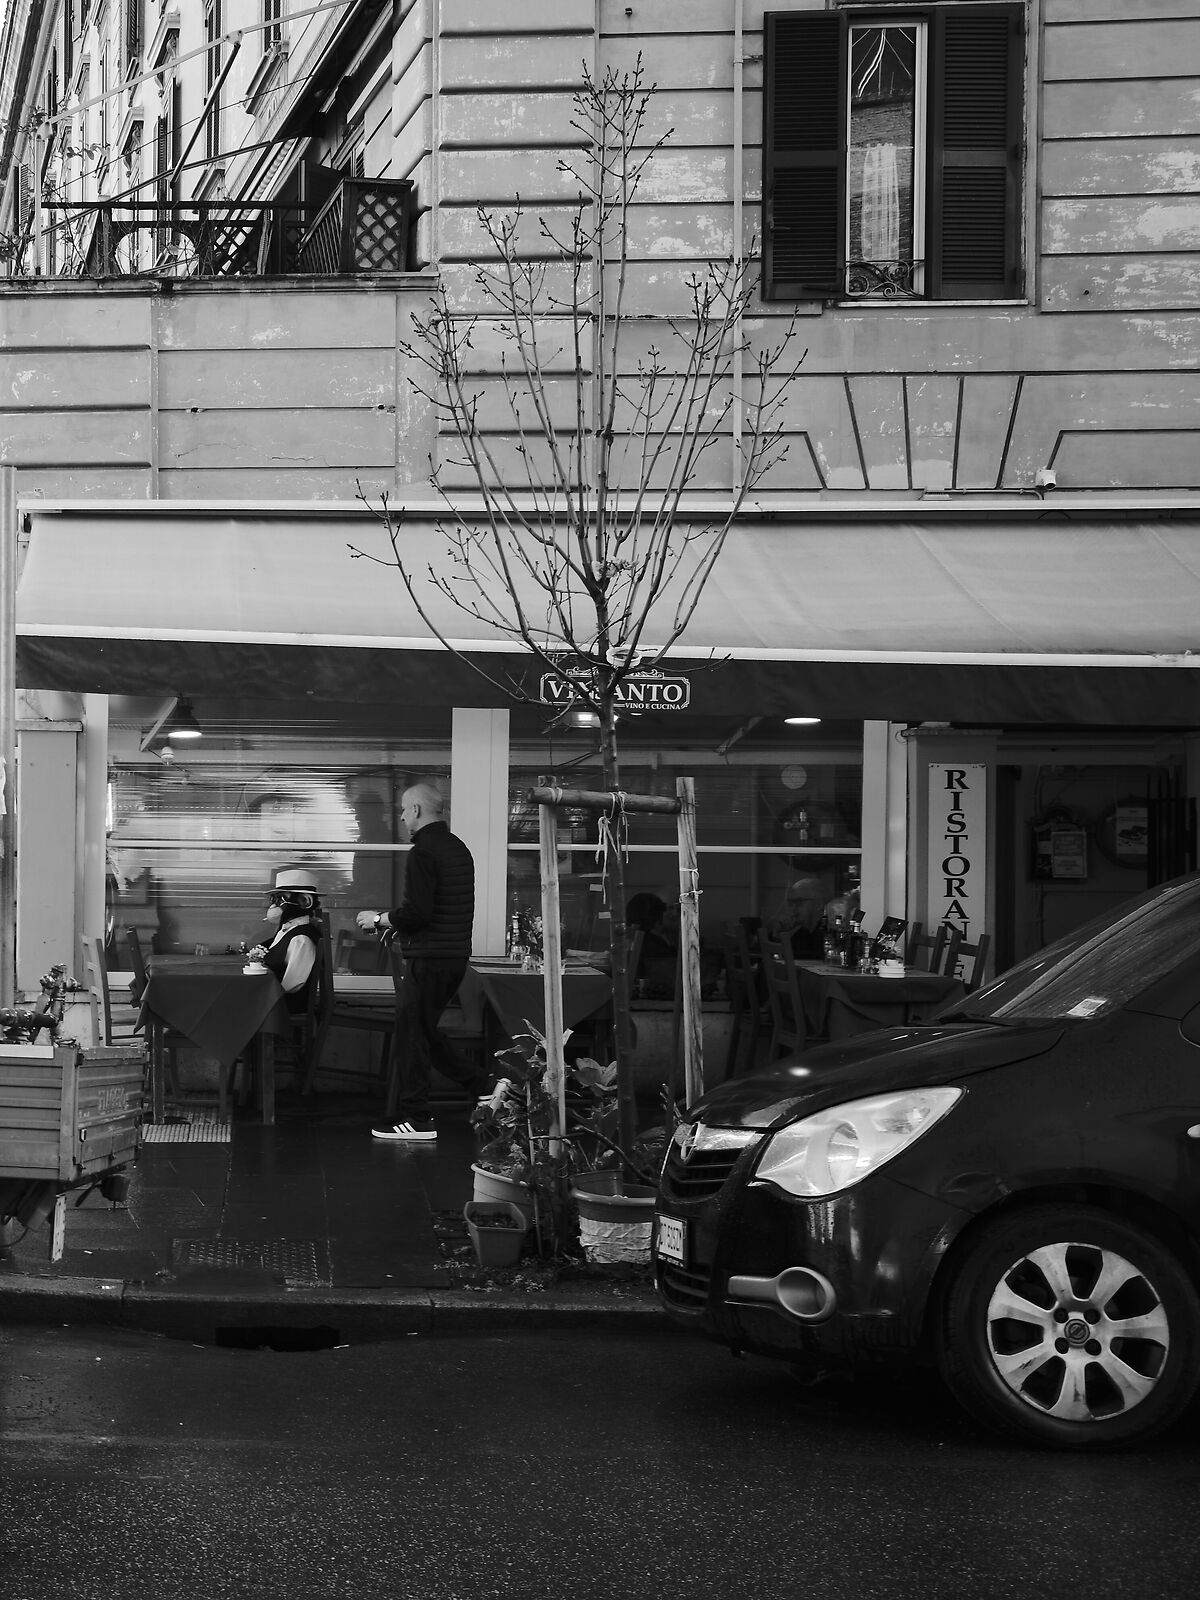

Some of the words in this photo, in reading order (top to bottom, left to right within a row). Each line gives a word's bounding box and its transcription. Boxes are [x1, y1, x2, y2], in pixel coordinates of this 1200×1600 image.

[548, 680, 683, 702] VINANTO
[625, 702, 645, 710] VINO
[650, 703, 681, 711] CUCINA
[942, 769, 971, 985] RISTORAN
